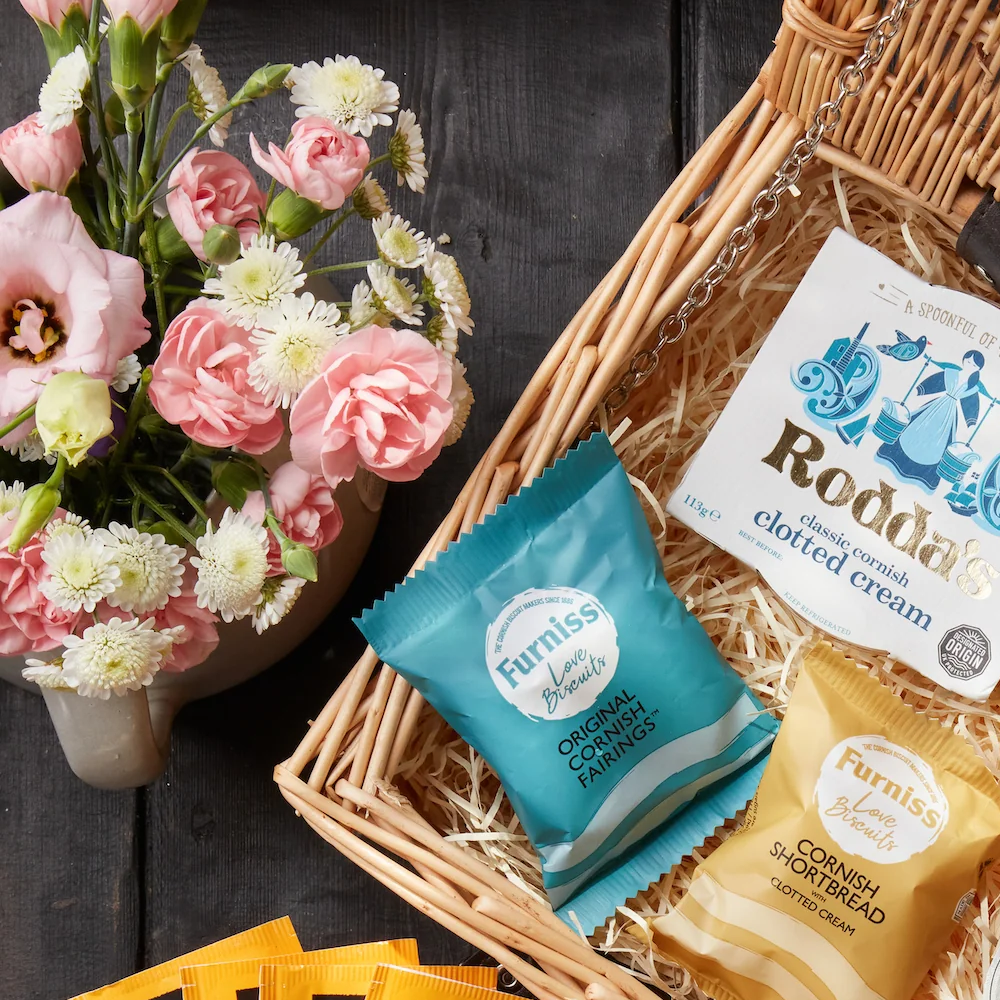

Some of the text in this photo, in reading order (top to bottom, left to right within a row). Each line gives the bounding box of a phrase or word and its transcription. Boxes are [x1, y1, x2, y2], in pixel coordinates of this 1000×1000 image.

[904, 300, 913, 314] A
[918, 302, 980, 340] SPOONFUL
[979, 332, 998, 350] OF
[760, 418, 1000, 600] Rodda's
[738, 529, 756, 545] BEST
[800, 514, 910, 588] classic cornish
[754, 509, 932, 632] clotted cream
[506, 605, 524, 623] BISCUIT
[523, 598, 544, 610] MAKERS
[784, 591, 852, 636] KEEP REFRIGERATED
[494, 644, 502, 654] THE
[496, 622, 510, 644] CORNISH
[496, 602, 599, 690] Furniss
[945, 638, 984, 669] ORIGIN
[953, 632, 986, 657] DESIGNATED
[542, 654, 606, 714] Biscuits
[547, 648, 587, 687] Love
[942, 653, 974, 677] UK PROTECTED
[558, 690, 636, 755] ORIGINAL
[569, 701, 646, 771] CORNISH
[835, 746, 940, 828] Furniss
[852, 791, 898, 828] Love
[825, 796, 898, 851] Biscuits
[770, 842, 886, 924] SHORTBREAD
[798, 839, 880, 899] CORNISH
[770, 877, 856, 936] CLOTTED CREAM
[811, 890, 826, 903] WITH
